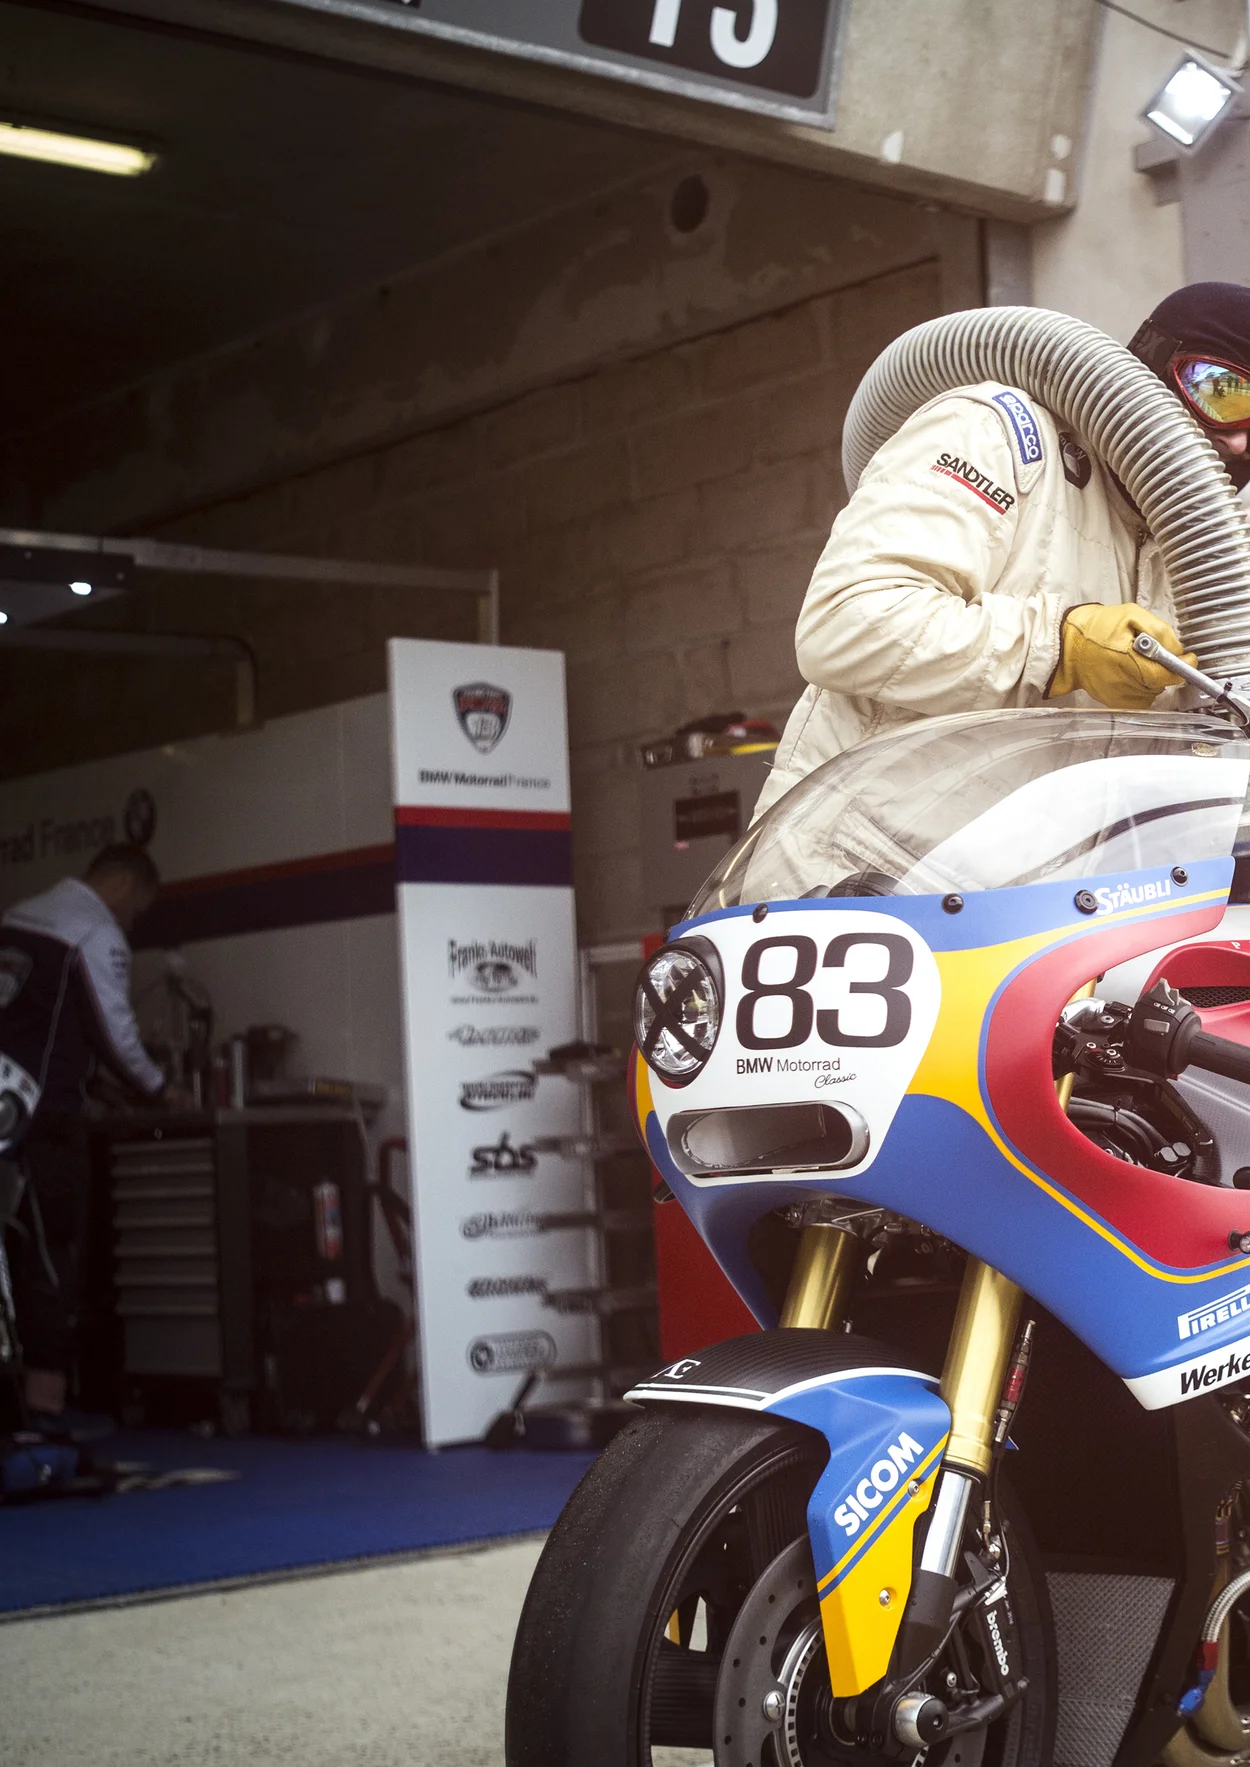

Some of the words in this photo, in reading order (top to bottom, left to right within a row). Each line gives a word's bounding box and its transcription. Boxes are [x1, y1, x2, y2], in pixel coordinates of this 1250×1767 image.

[999, 394, 1040, 460] sparco
[936, 452, 1016, 511] SANDTLER
[1094, 879, 1172, 916] STÄUBLI
[735, 932, 914, 1051] 83
[736, 1057, 773, 1075] BMW
[776, 1057, 841, 1073] Motorrad
[814, 1072, 857, 1089] Classic
[833, 1431, 924, 1537] SICOM
[986, 1609, 1010, 1677] brembo
